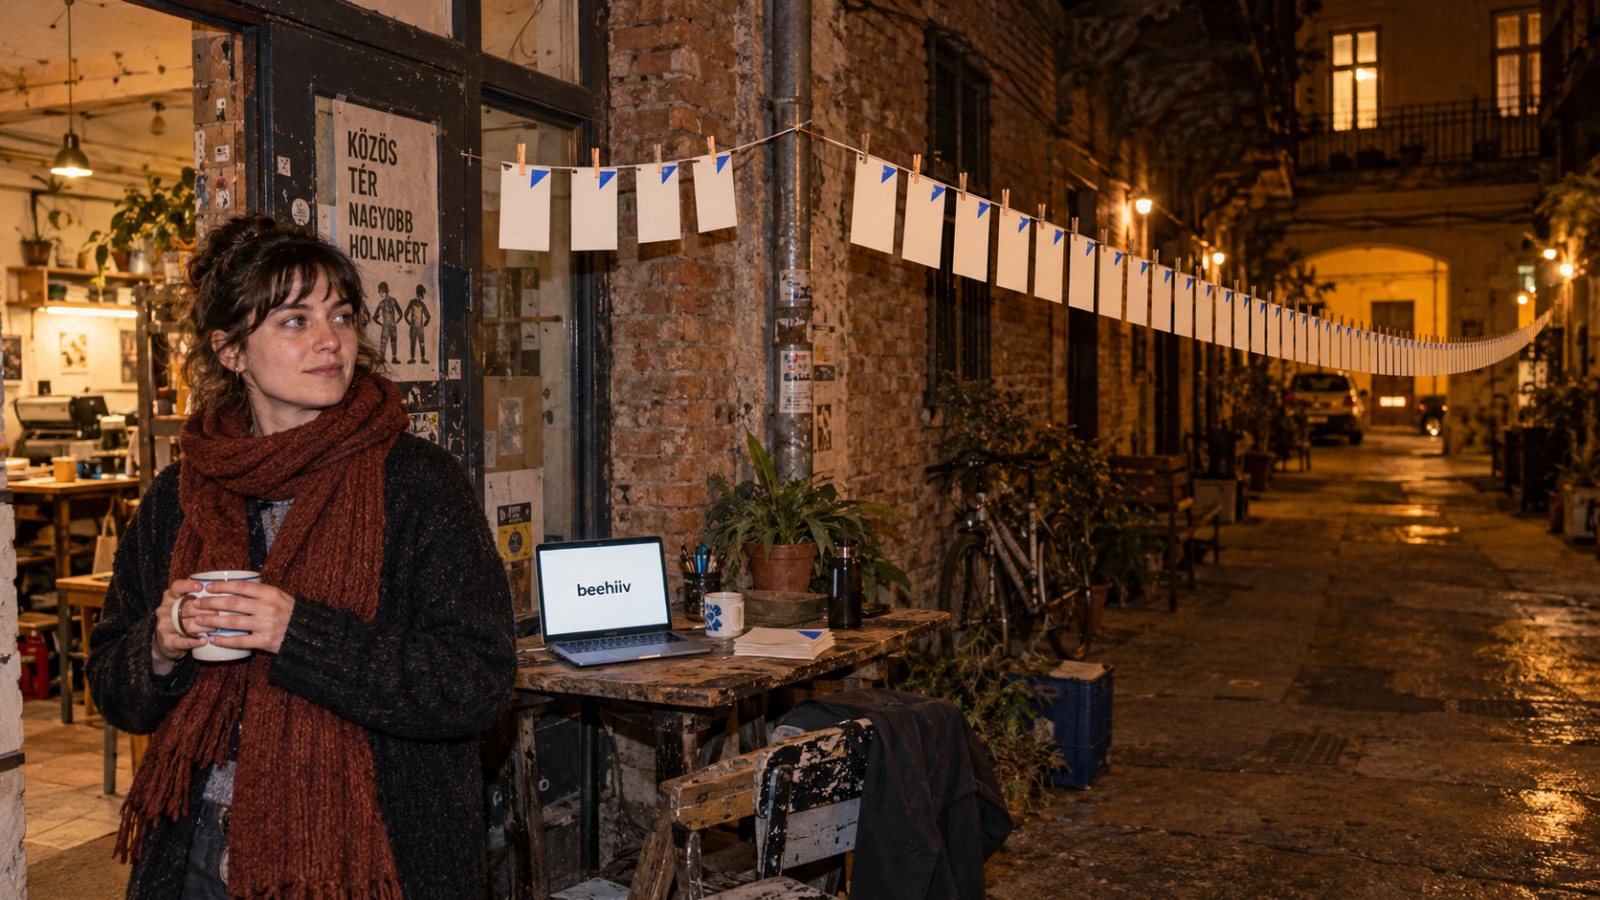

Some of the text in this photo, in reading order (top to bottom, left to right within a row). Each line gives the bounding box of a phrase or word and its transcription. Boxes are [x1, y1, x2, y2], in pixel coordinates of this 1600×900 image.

[348, 128, 397, 166] KÖZÖS
[348, 163, 378, 197] TÉR
[349, 202, 413, 234] NAGYOBB
[349, 234, 428, 265] HOLNAPÉRT
[577, 580, 631, 597] beehiiv
